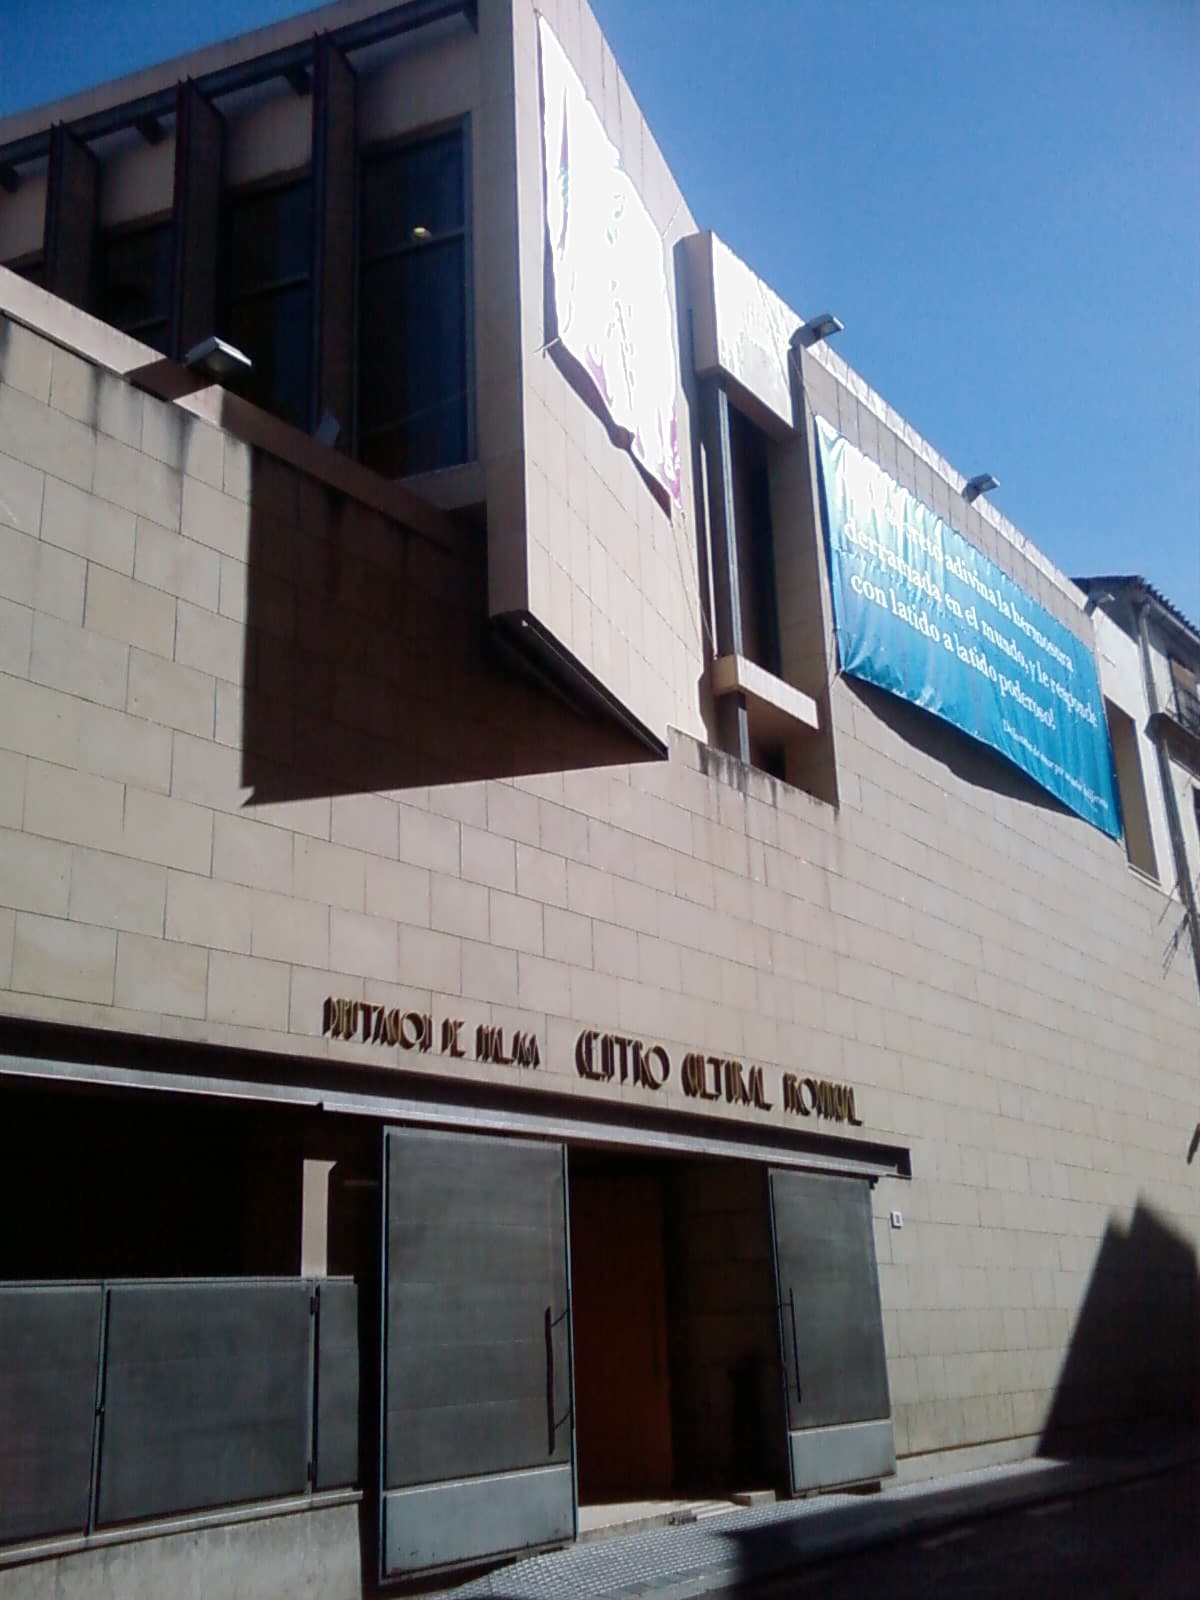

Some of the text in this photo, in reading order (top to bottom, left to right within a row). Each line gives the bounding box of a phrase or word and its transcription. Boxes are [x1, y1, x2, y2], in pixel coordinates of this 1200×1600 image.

[843, 519, 943, 603] derramada
[944, 593, 964, 619] en
[964, 606, 979, 631] el
[1036, 661, 1050, 688] le
[851, 575, 888, 609] con
[889, 588, 940, 642] latido
[943, 632, 955, 653] a
[953, 632, 998, 682] latido
[944, 553, 997, 606] adivina
[996, 590, 1012, 620] la
[441, 1016, 466, 1058] DE
[575, 1029, 670, 1091] CENTRO
[681, 1052, 772, 1112] CULTURAL
